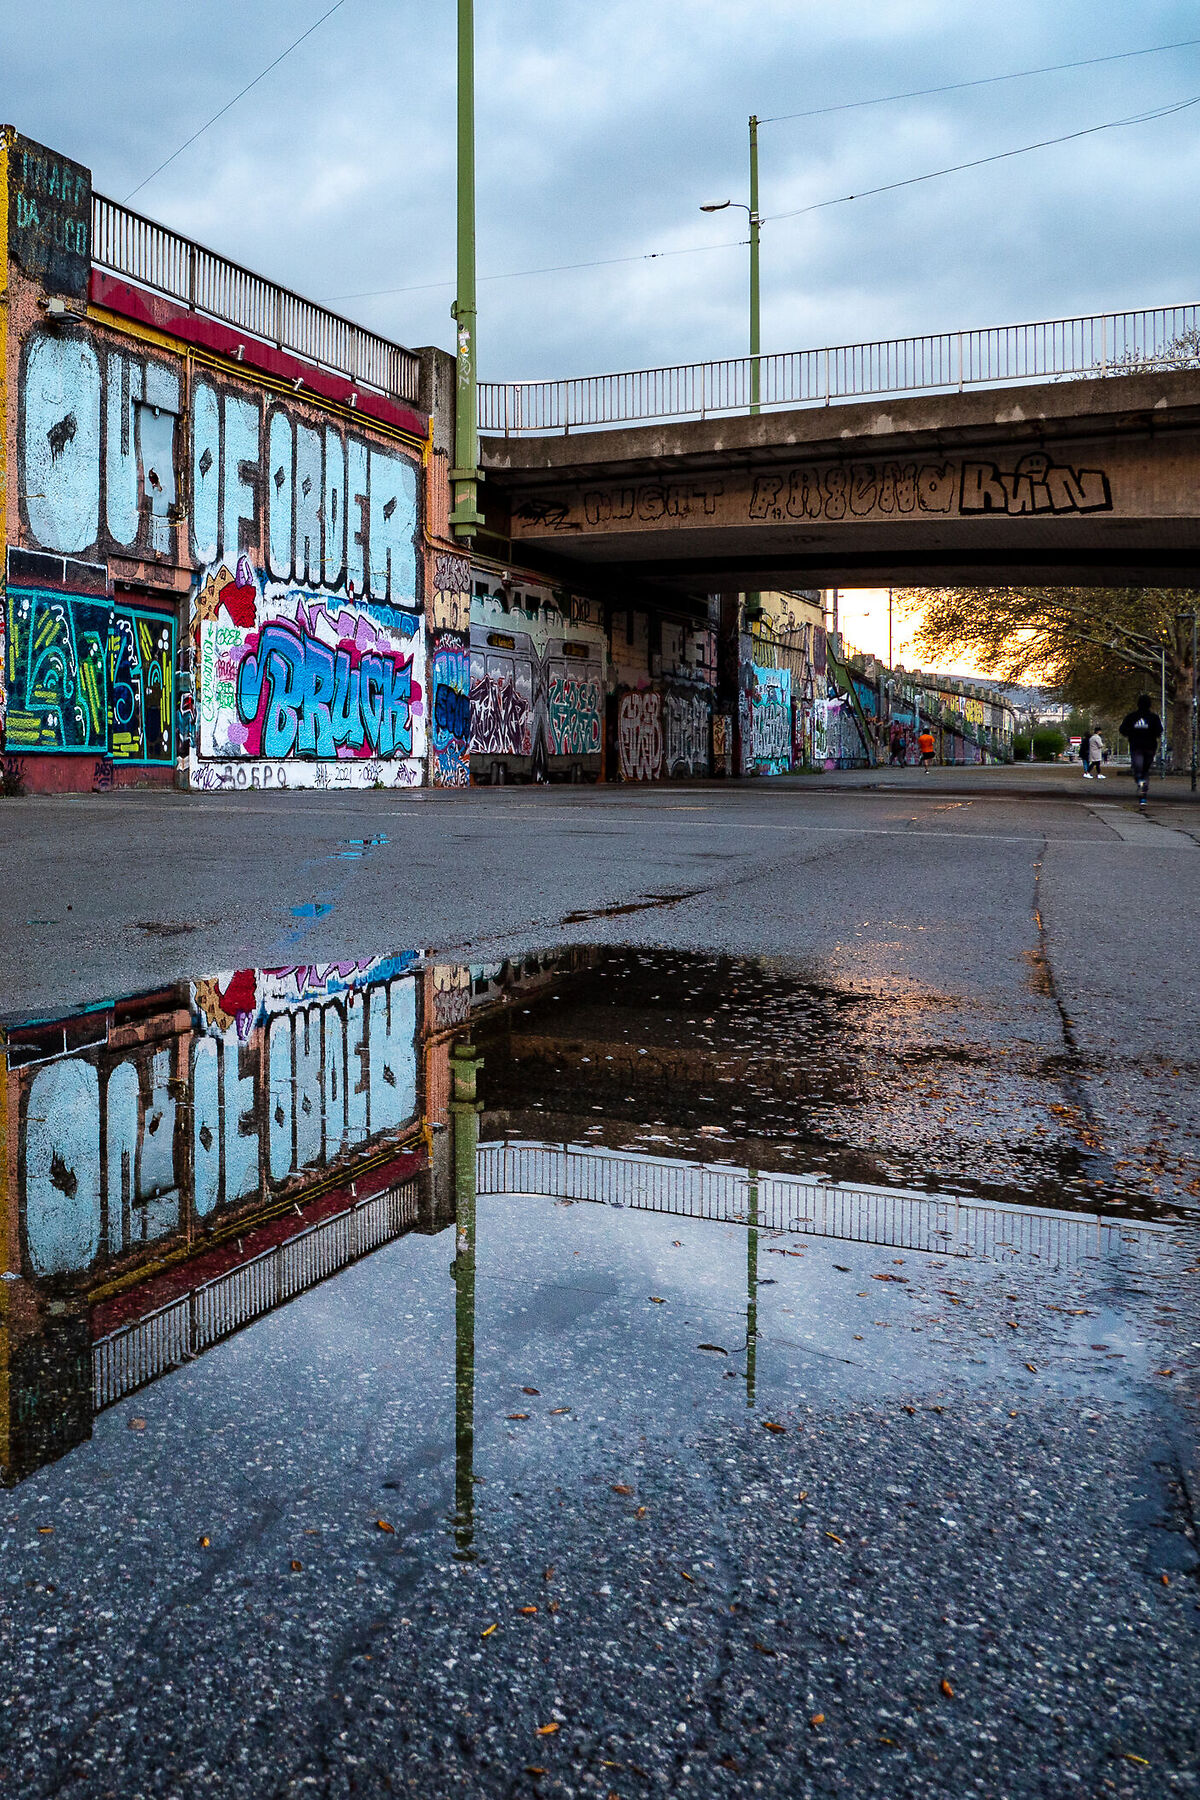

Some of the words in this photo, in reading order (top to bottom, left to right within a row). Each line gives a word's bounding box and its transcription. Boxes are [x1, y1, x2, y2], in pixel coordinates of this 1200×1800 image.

[18, 328, 180, 560] OUT
[191, 380, 263, 564] OF
[266, 400, 424, 614] ORDER
